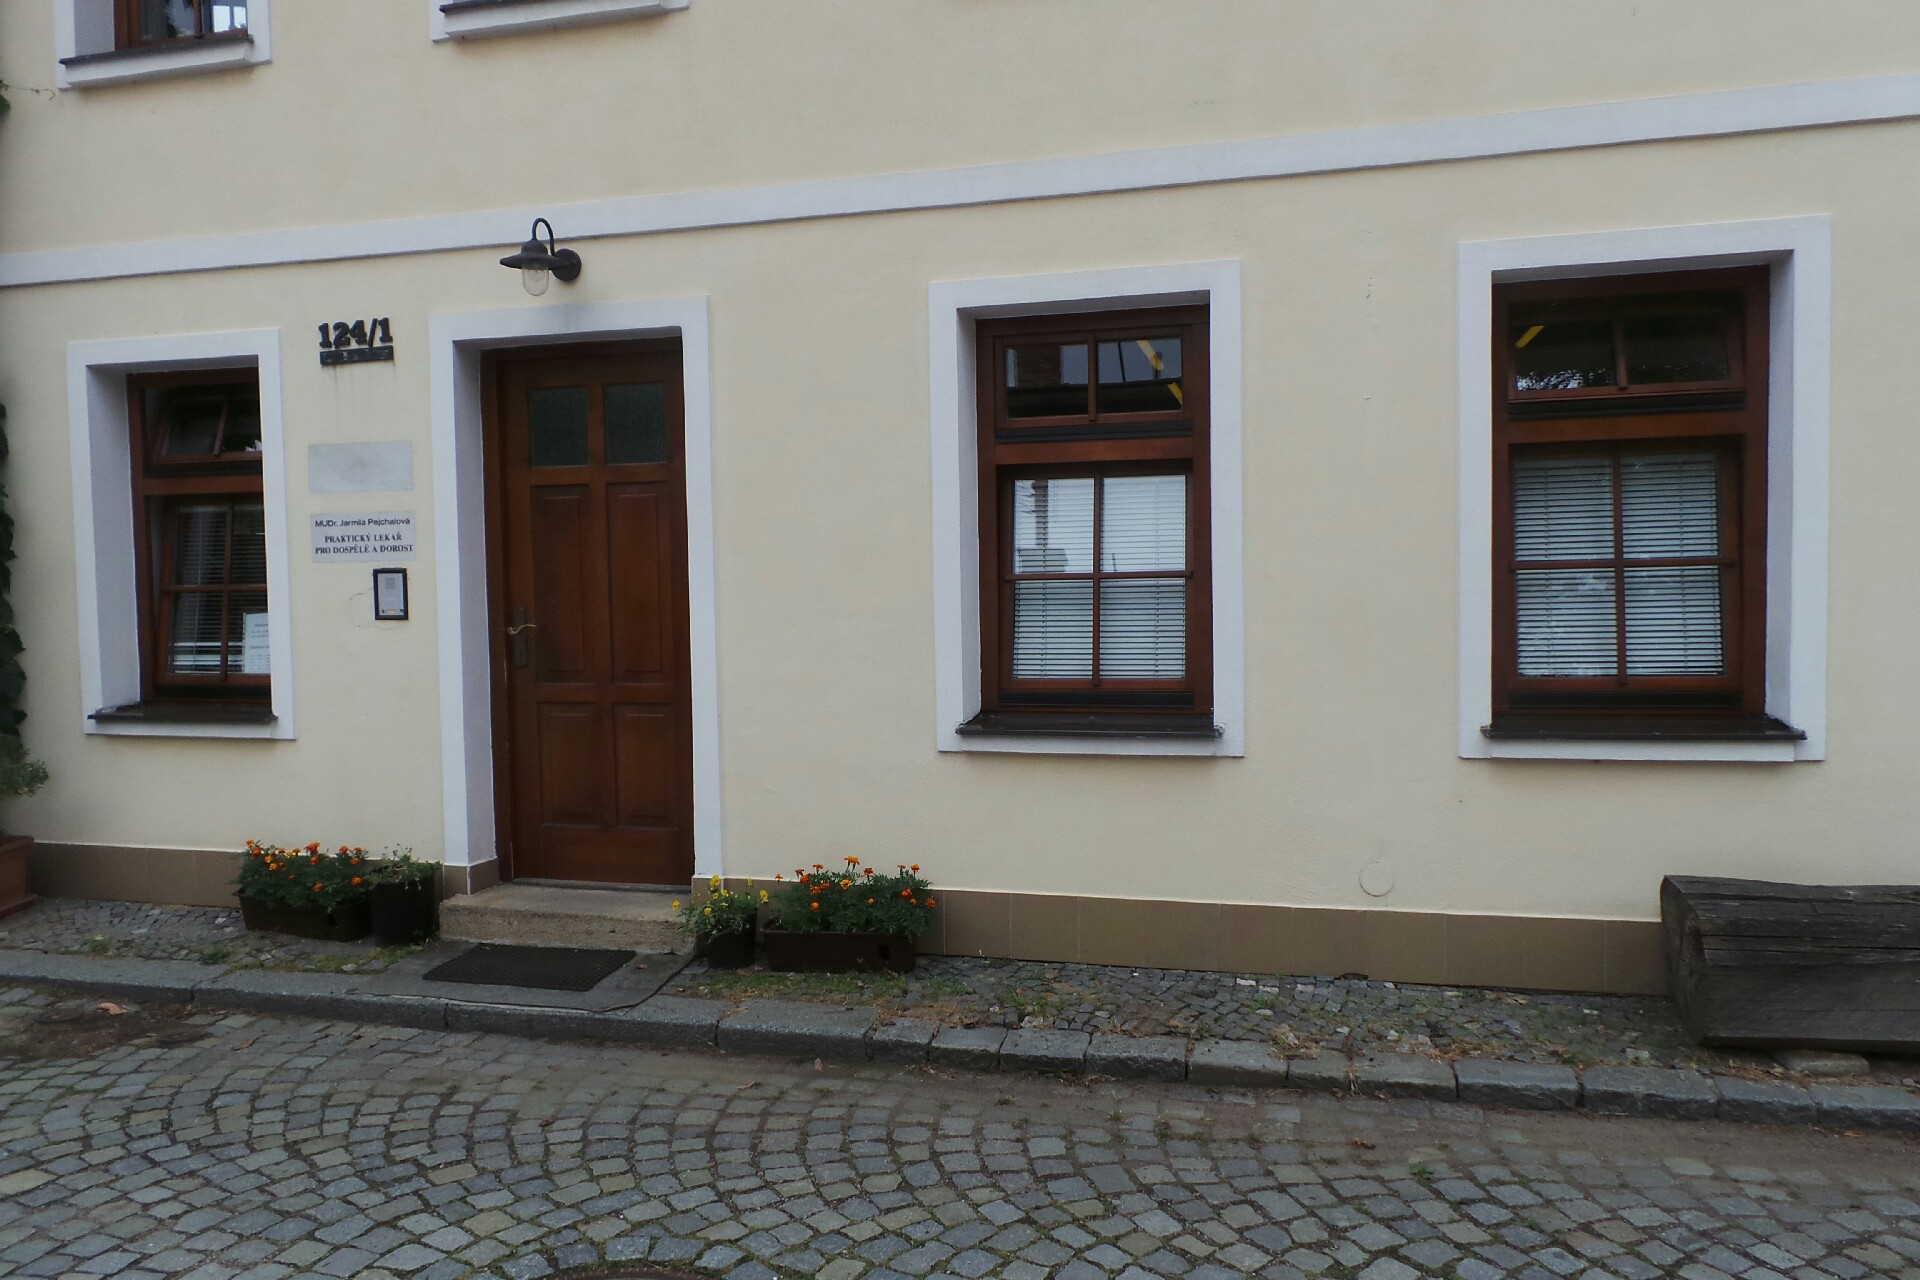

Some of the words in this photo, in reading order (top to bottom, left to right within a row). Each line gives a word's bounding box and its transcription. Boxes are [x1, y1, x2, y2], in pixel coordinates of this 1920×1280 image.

[318, 317, 393, 349] 124/1
[315, 519, 338, 527] MUDr.
[340, 519, 366, 527] Jarmila
[324, 533, 370, 543] PRAKTICKÝ
[315, 546, 331, 554] PRO
[380, 544, 413, 552] DOROST
